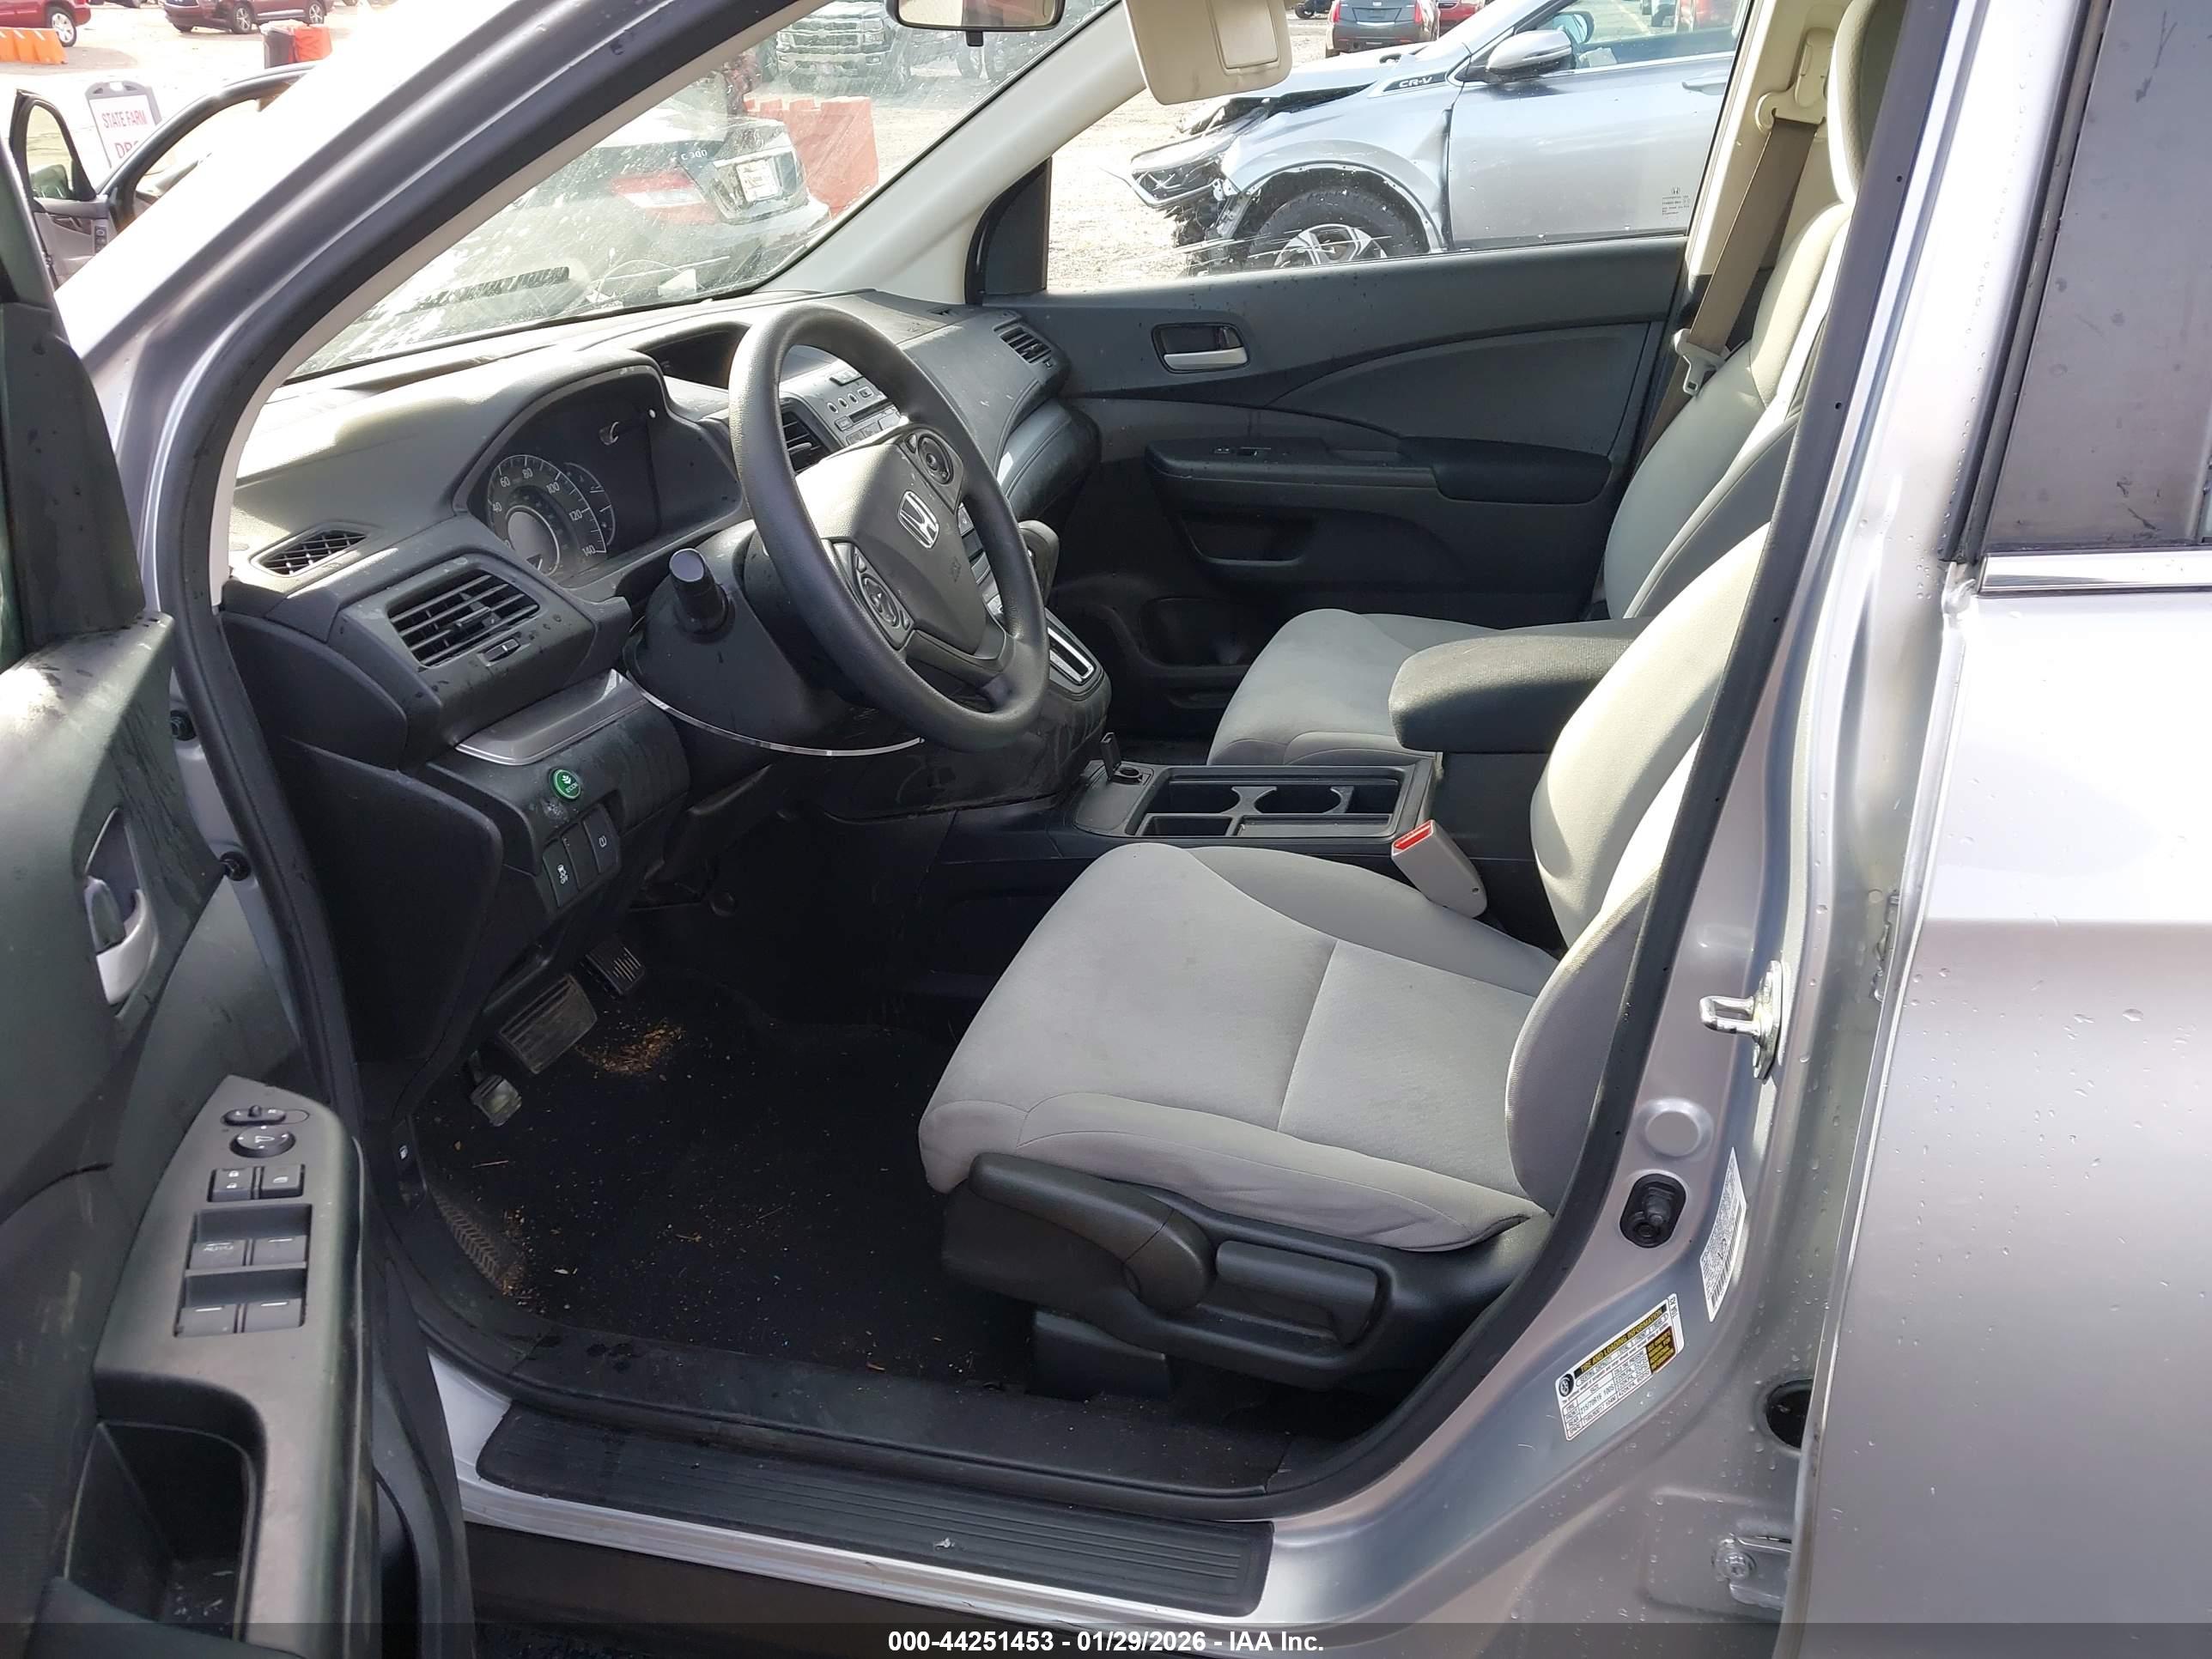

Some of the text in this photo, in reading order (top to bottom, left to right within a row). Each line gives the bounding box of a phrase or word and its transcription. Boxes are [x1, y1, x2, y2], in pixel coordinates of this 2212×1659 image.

[1399, 76, 1432, 88] CR-V
[101, 110, 148, 128] STATE FARM
[114, 140, 138, 158] DR
[522, 468, 533, 479] 80
[500, 476, 511, 488] 60
[546, 482, 561, 495] 100
[492, 501, 503, 514] 40
[568, 508, 583, 521] 120
[581, 544, 597, 556] 140
[1580, 1359, 1592, 1373] TIRE
[1591, 1350, 1603, 1364] AND
[1603, 1334, 1626, 1356] LOADING
[1626, 1307, 1662, 1339] INFORMATION
